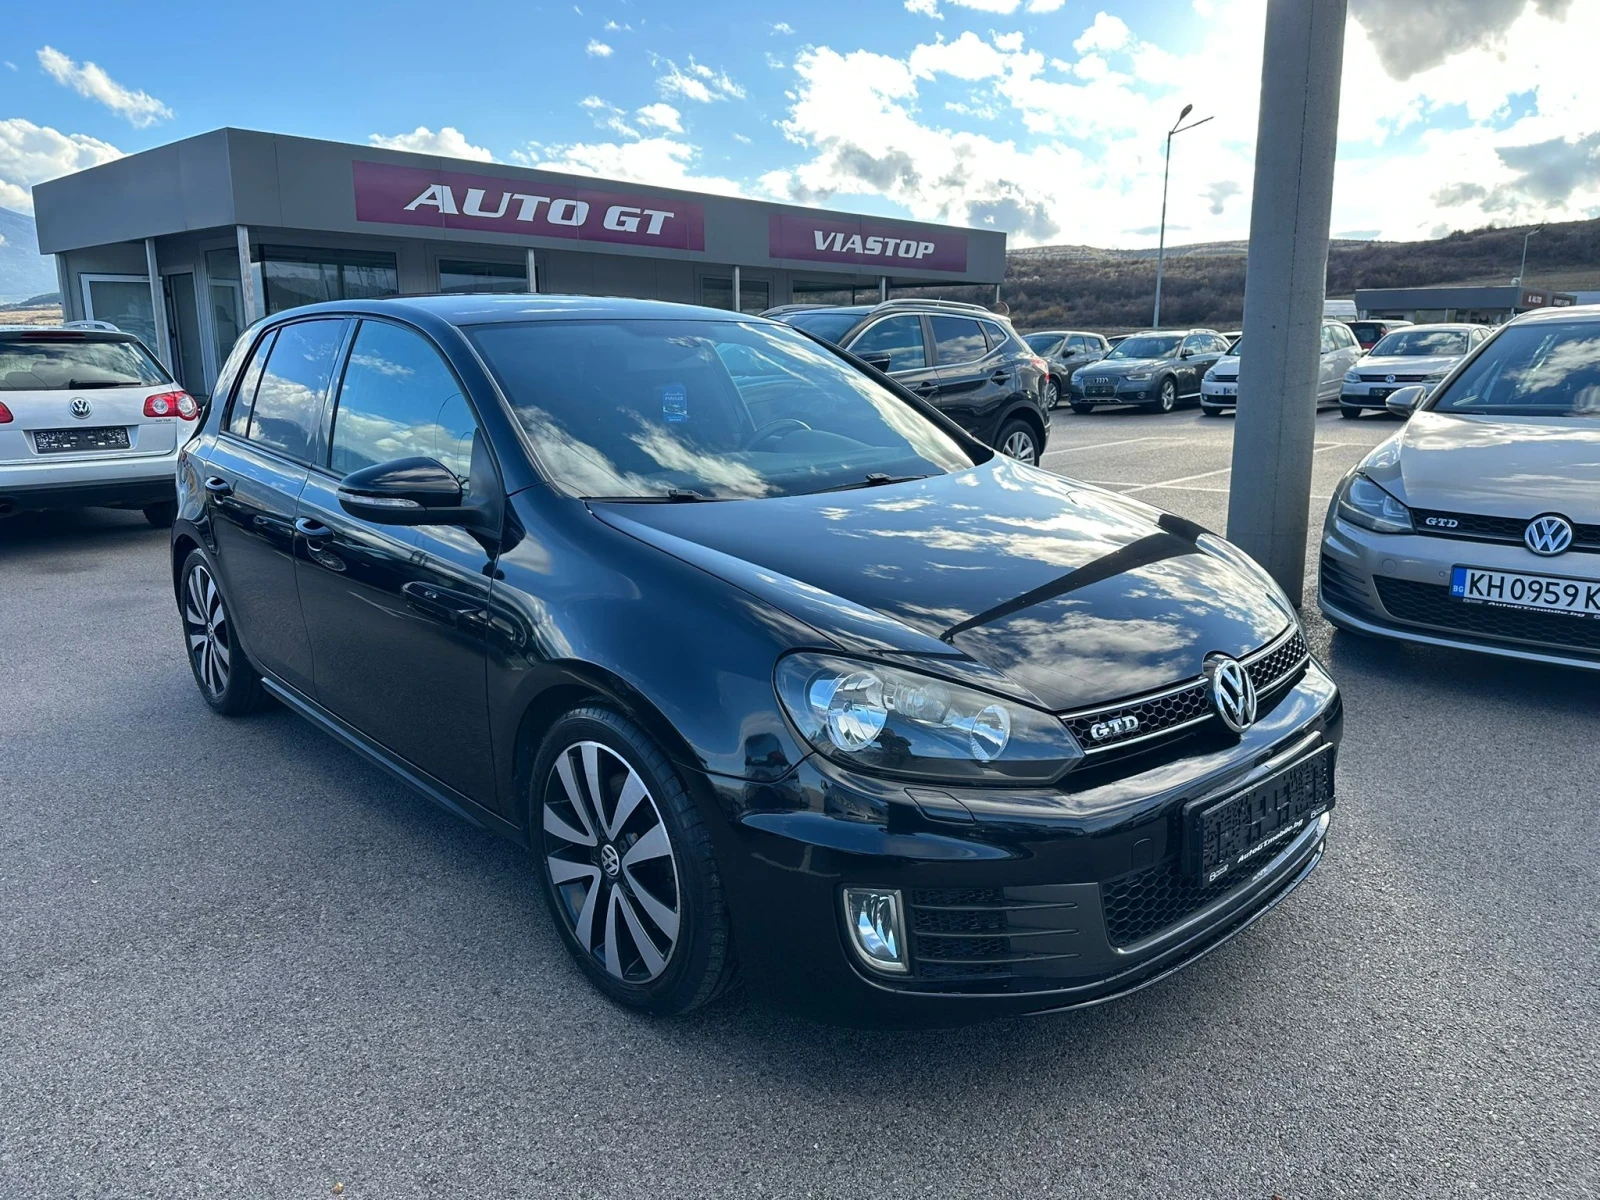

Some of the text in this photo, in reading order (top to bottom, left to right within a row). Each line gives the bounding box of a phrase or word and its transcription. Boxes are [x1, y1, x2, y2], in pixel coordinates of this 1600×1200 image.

[403, 184, 675, 235] AUTO GT
[813, 230, 935, 259] VIASTOP
[1425, 517, 1459, 528] GTD
[1453, 585, 1464, 593] BG
[1090, 715, 1139, 740] GTD
